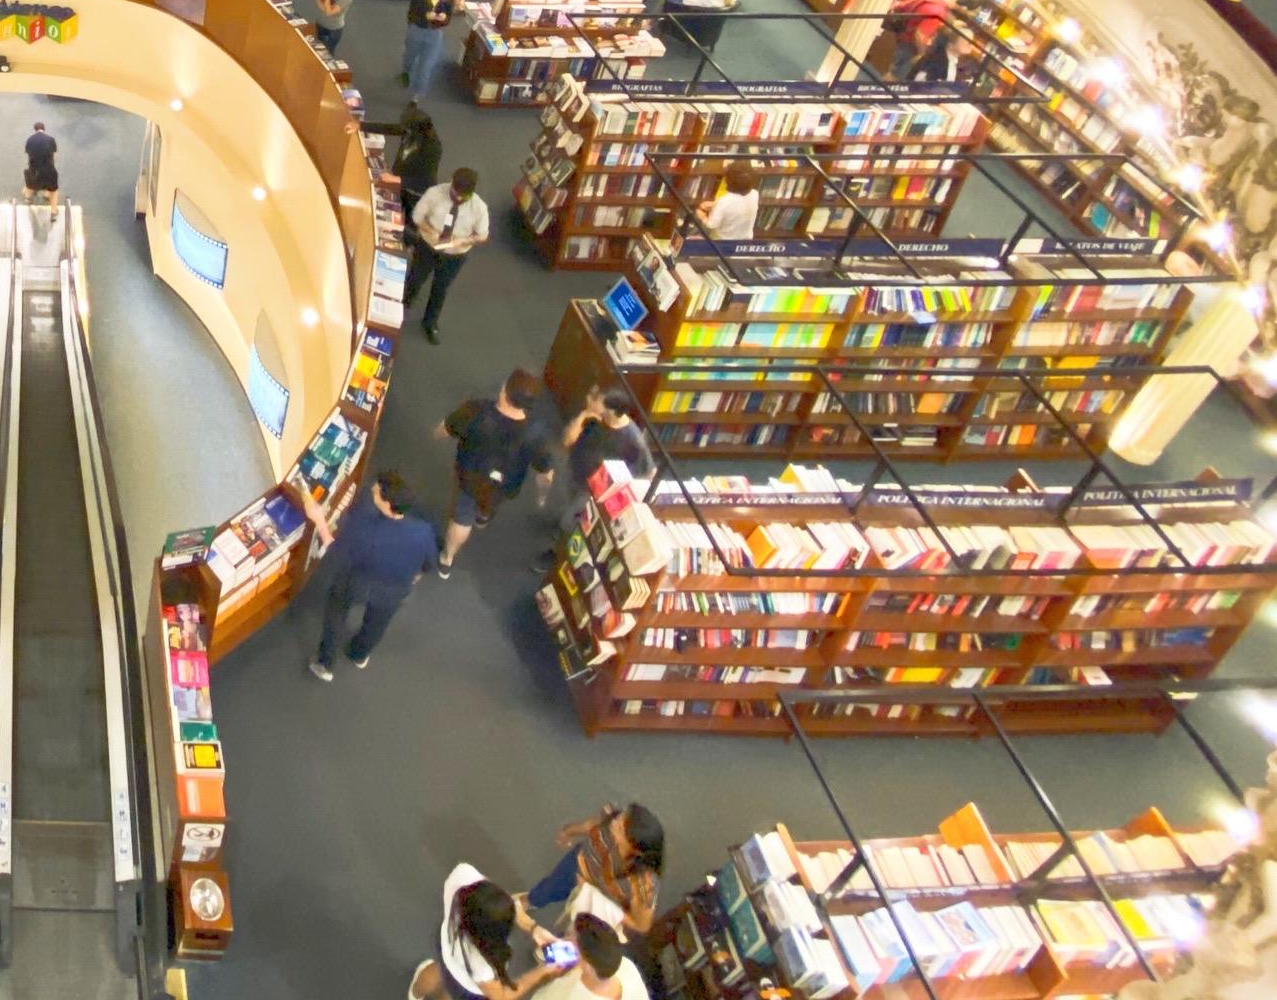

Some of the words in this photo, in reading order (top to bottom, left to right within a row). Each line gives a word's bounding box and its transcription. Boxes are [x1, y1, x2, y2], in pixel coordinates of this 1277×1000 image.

[735, 244, 786, 254] DERECHO
[898, 243, 949, 253] DERECHO
[1083, 490, 1140, 502] POLITIA
[1141, 485, 1237, 499] INTERNACIONAL
[736, 496, 842, 504] INTERNACIONAL
[877, 494, 939, 505] POLIICA
[940, 495, 1045, 507] INTERNACIONAL
